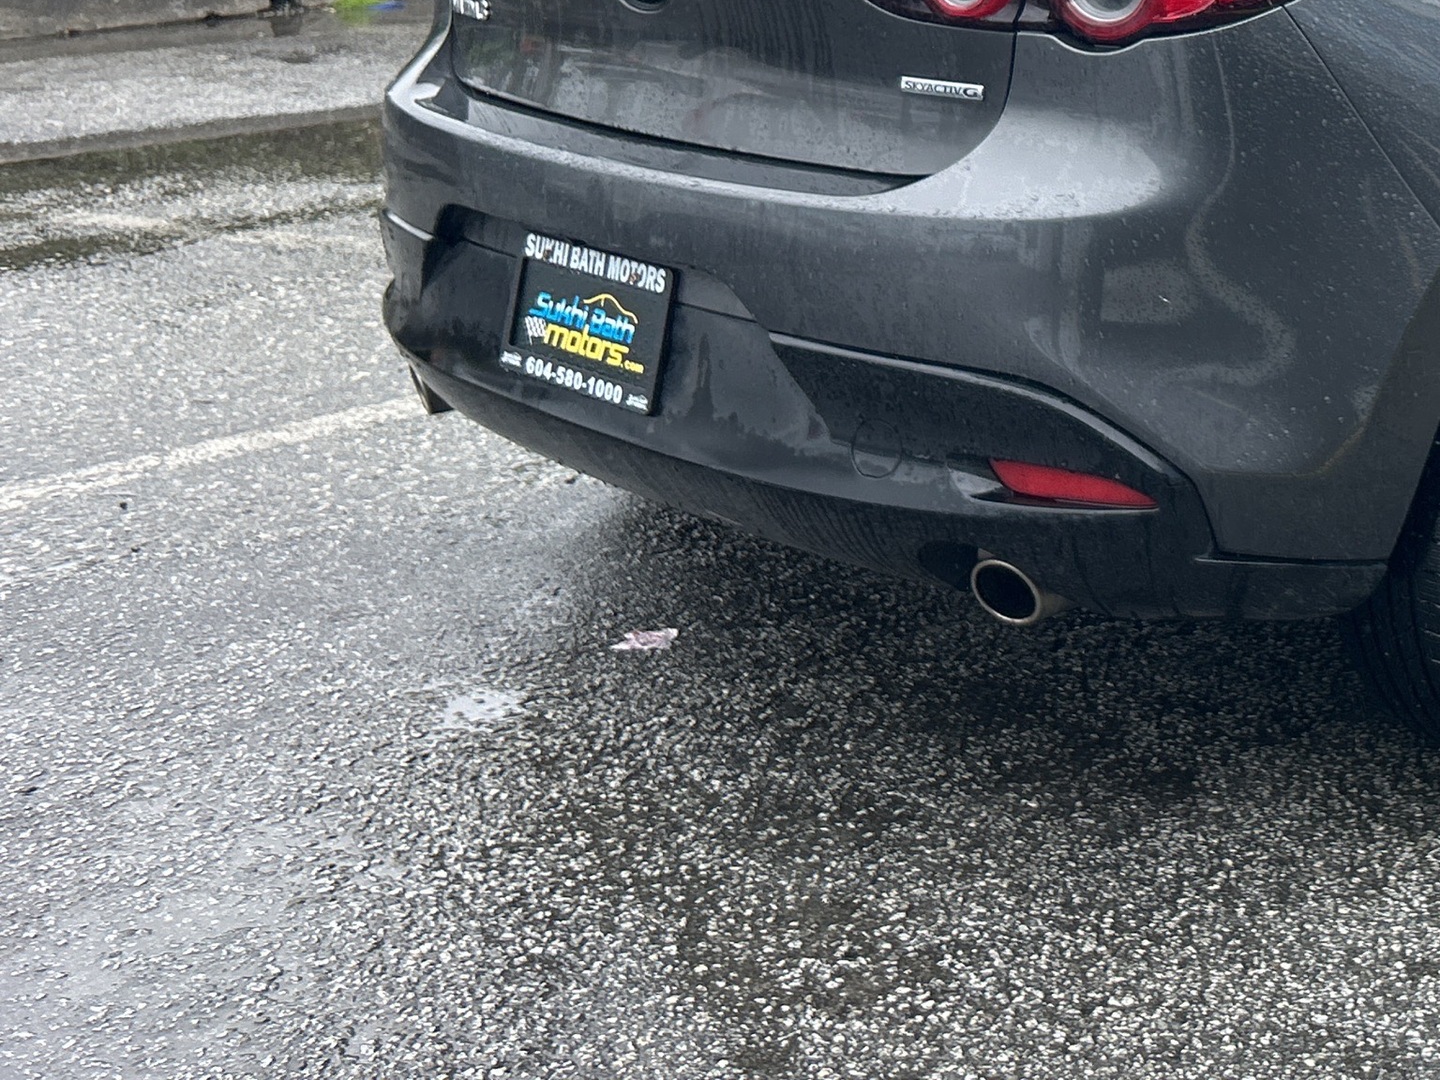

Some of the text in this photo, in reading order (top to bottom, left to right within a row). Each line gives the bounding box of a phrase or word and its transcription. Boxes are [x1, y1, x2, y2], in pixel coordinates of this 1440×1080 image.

[570, 246, 605, 277] BATH
[528, 291, 635, 344] Sukhi Bath
[525, 356, 623, 404] 604-580-1000
